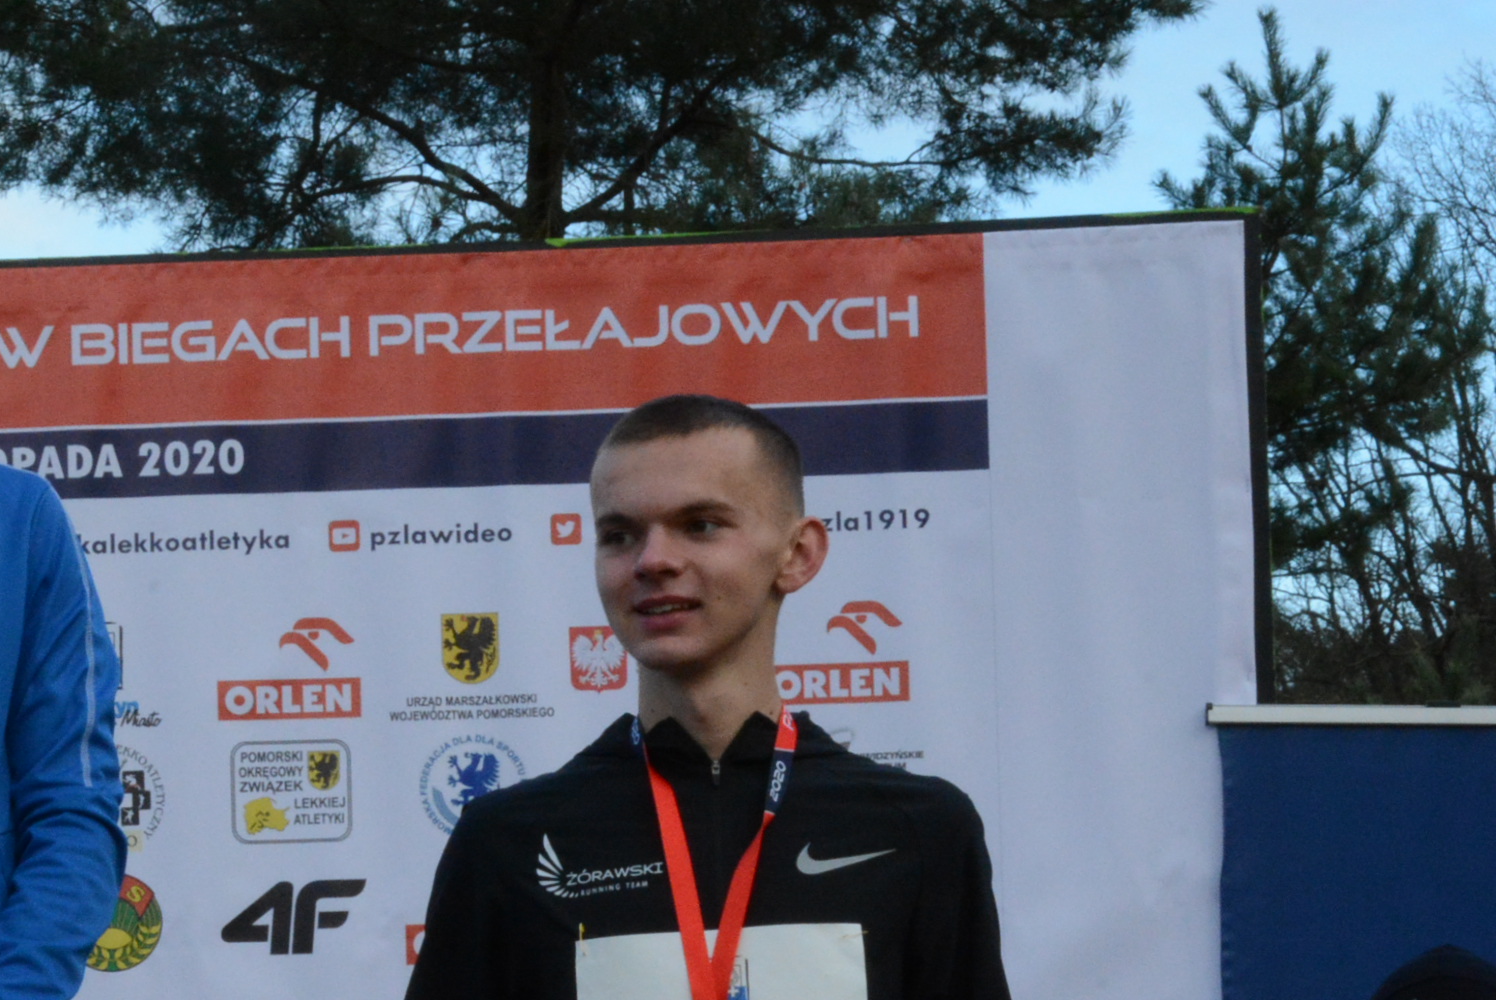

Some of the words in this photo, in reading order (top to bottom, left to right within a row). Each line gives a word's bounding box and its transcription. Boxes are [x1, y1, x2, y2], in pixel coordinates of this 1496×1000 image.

[71, 315, 350, 366] BIEGACH
[369, 295, 919, 356] PRZEŁAJOWYCH
[139, 438, 245, 478] 2020
[821, 508, 930, 531] zla1919
[76, 531, 291, 555] kalekkoatletyka
[370, 523, 513, 551] pzlawideo
[775, 667, 901, 700] ORLEN
[224, 683, 354, 715] ORLEN
[475, 706, 555, 720] POMORSKIEGO
[240, 751, 303, 763] POMORSKI
[239, 766, 303, 780] OKRĘGOWY
[239, 780, 303, 796] ZWIĄZEK
[294, 797, 346, 809] LEKKIEJ
[293, 812, 345, 825] ATLETYKI
[566, 861, 664, 887] ŻÓRAWSKI
